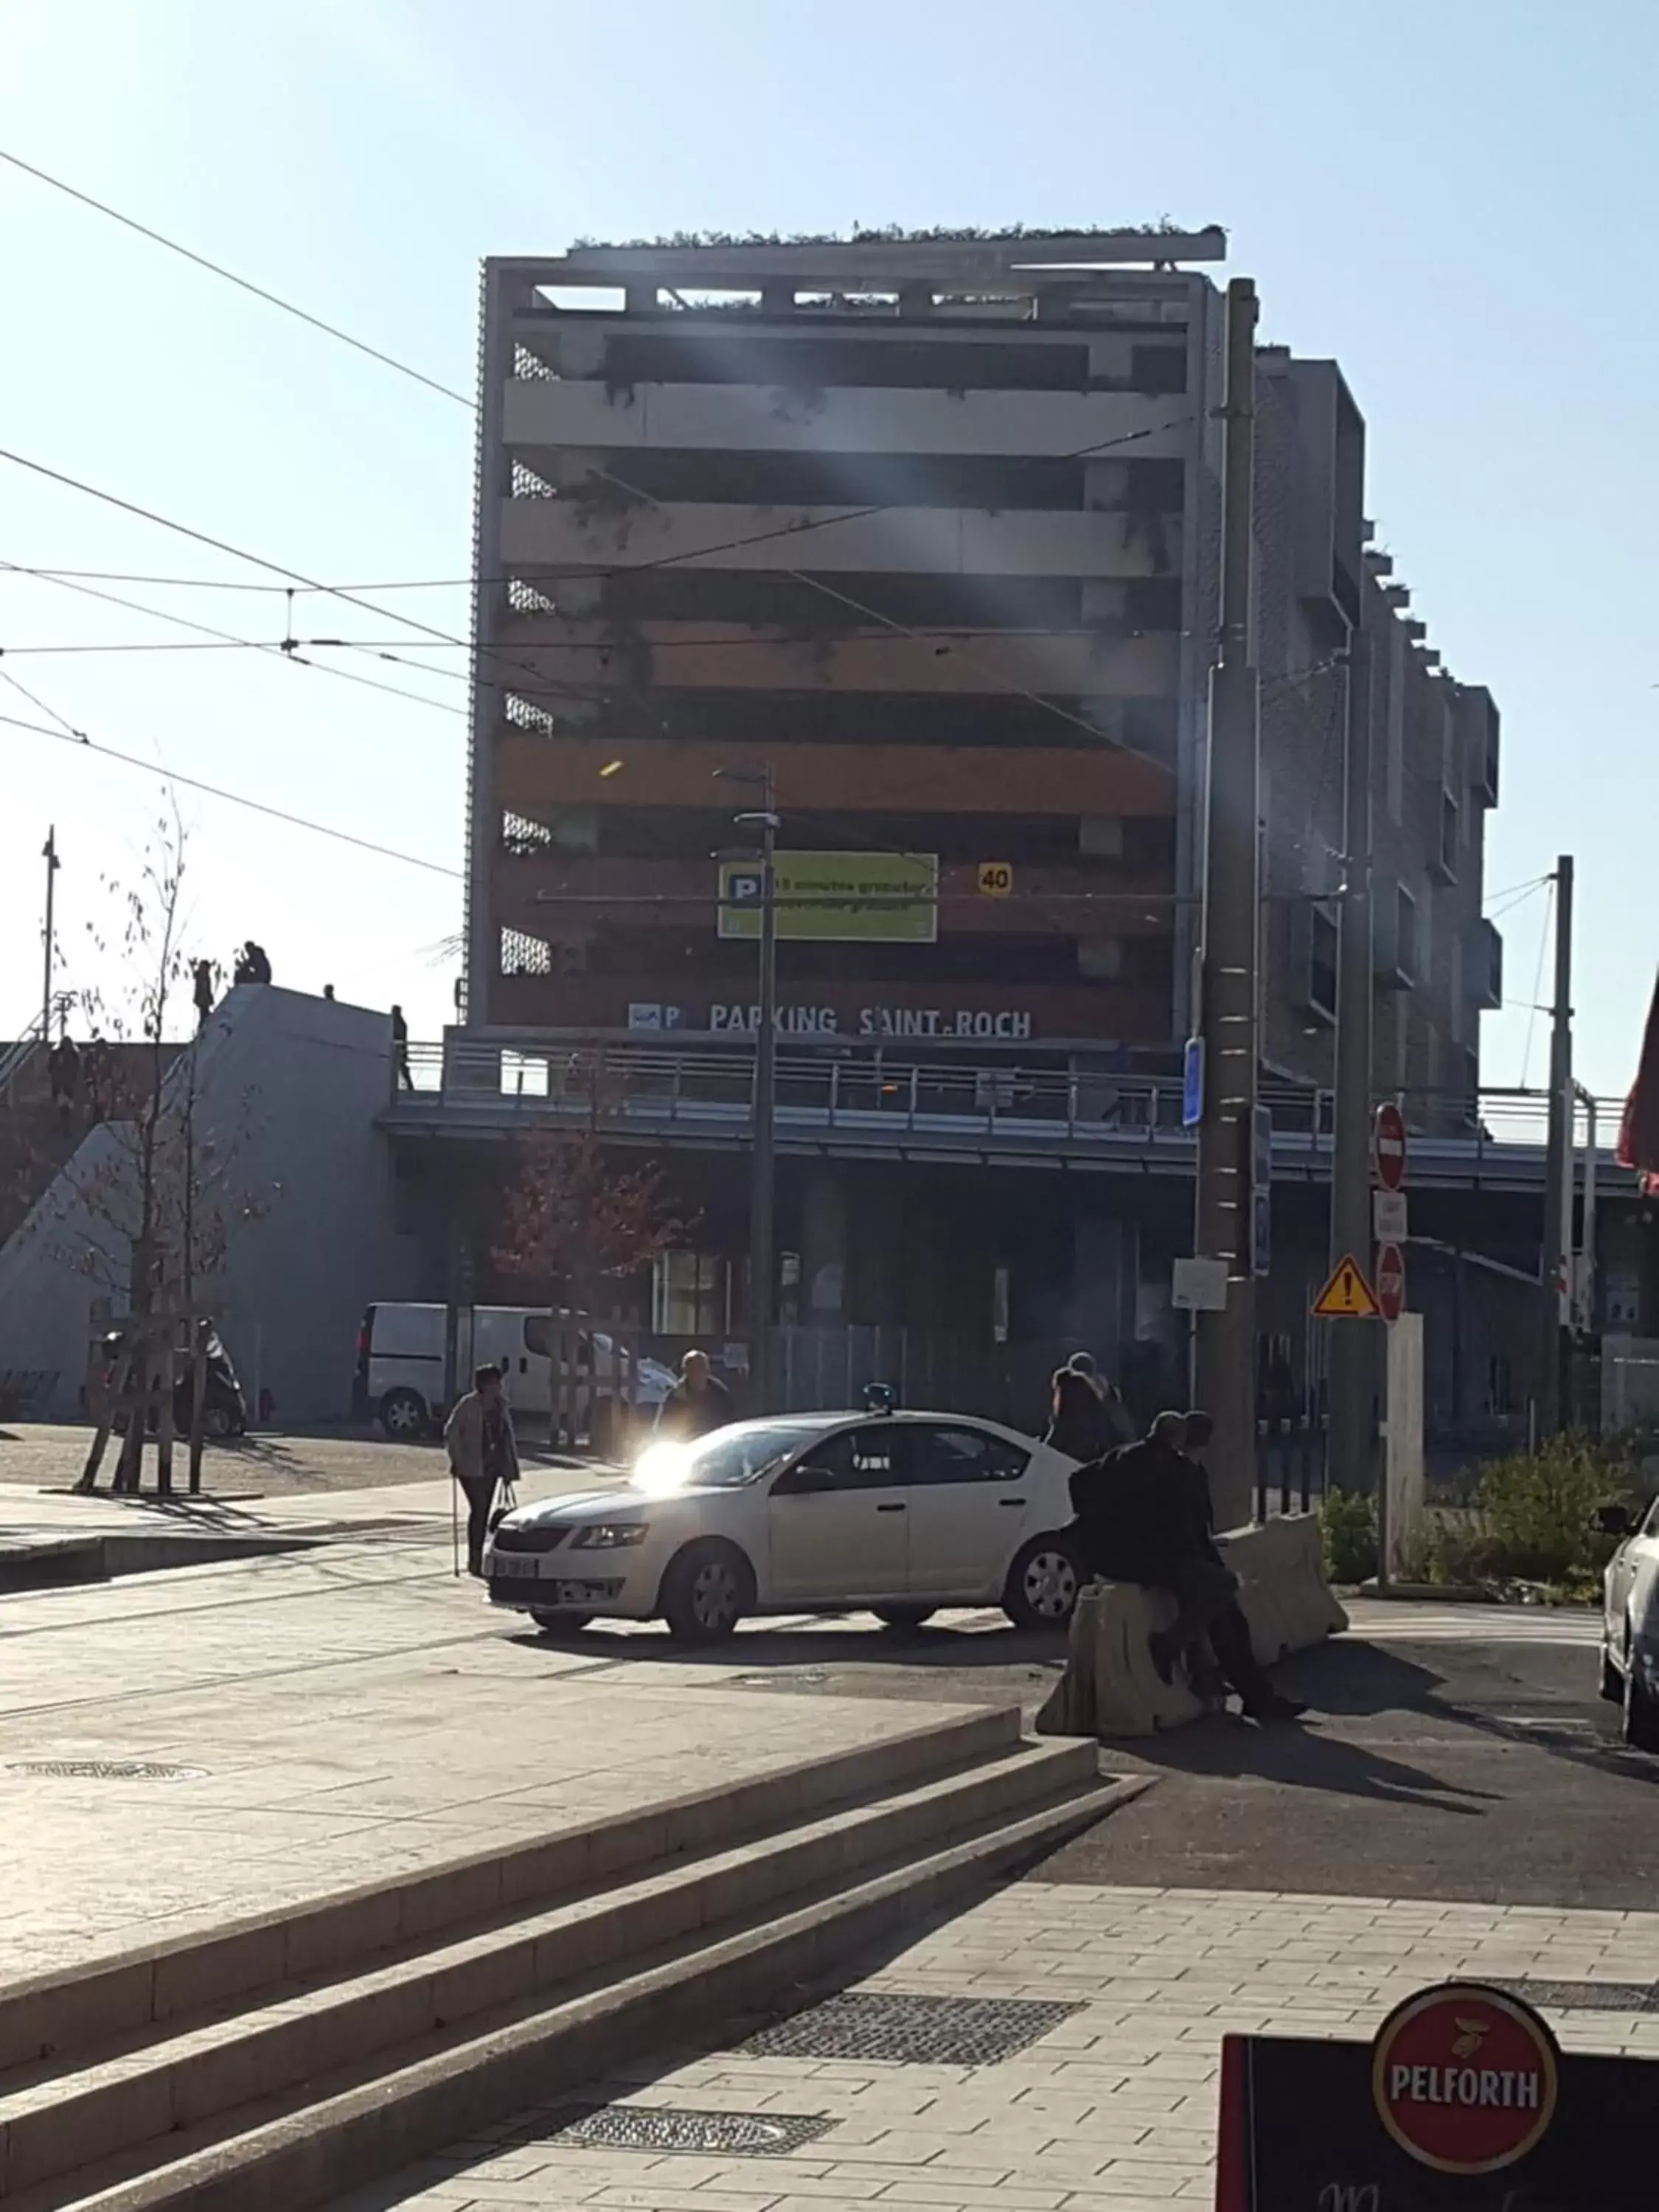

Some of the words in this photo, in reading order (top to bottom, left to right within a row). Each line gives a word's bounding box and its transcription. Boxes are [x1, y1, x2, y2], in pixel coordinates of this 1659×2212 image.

[736, 878, 757, 899] P
[982, 869, 1009, 889] 40
[666, 1006, 681, 1028] P
[1391, 2064, 1538, 2109] PELFORTH
